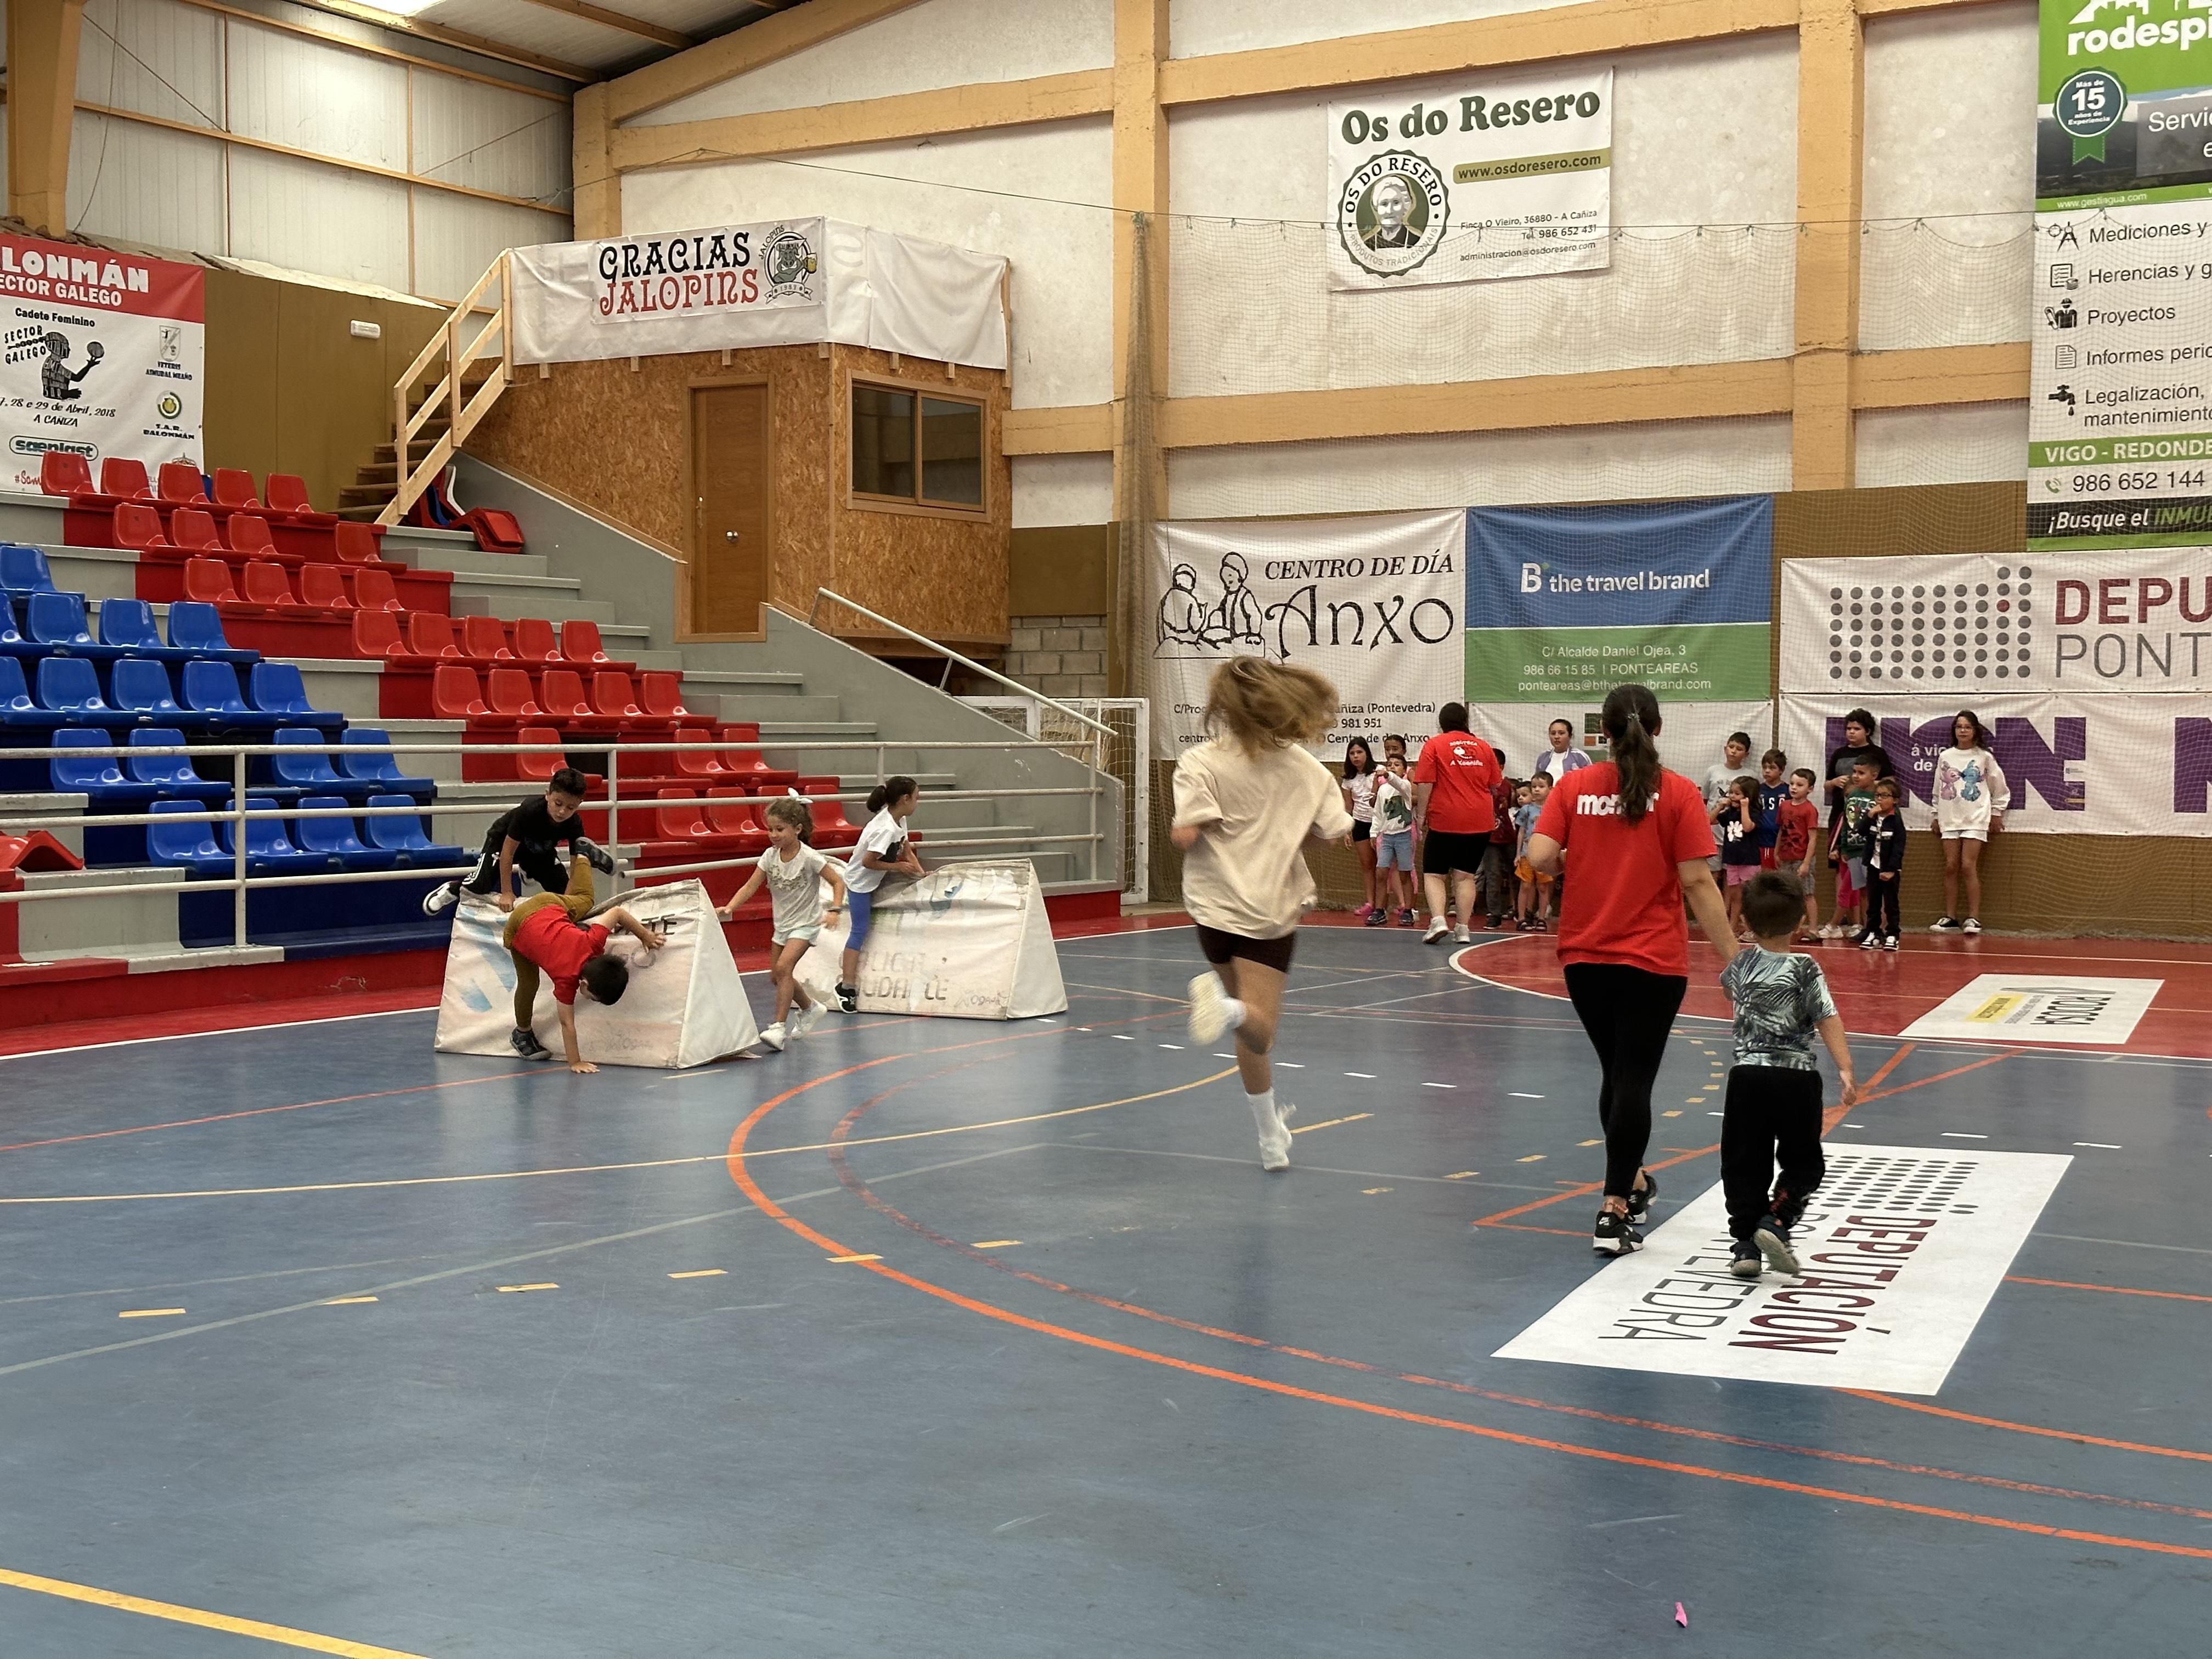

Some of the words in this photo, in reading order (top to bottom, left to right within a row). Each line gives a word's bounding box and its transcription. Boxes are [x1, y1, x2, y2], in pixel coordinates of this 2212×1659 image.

[2072, 87, 2106, 111] 15
[1342, 110, 1388, 144] Os
[1400, 103, 1448, 138] do
[1459, 92, 1600, 132] Resero
[2068, 116, 2110, 126] Experiencia
[1458, 154, 1601, 179] www.osdoresero.com
[1346, 188, 1359, 213] OS
[1357, 163, 1382, 186] DO
[1388, 157, 1442, 206] RESERO
[1524, 214, 1552, 223] 36880
[1571, 210, 1598, 219] Cañiza
[1538, 229, 1558, 239] 986
[1561, 227, 1579, 236] 652
[2090, 222, 2191, 243] Mediciones
[2197, 221, 2208, 238] y
[599, 232, 750, 283] GRACIAS
[2089, 264, 2179, 284] Herencias
[2185, 264, 2195, 280] y
[55, 283, 122, 306] GALEGO
[600, 269, 758, 315] JALOPINS
[15, 308, 49, 320] Cadete
[52, 313, 95, 327] Feminino
[2087, 307, 2175, 326] Proyectos
[4, 325, 43, 343] SECTOR
[5, 346, 47, 364] GALEGO
[2086, 349, 2164, 365] Informes
[2085, 383, 2204, 407] Legalización,
[10, 398, 24, 407] 28
[35, 401, 49, 409] 29
[51, 403, 63, 411] de
[93, 408, 116, 417] 2018
[33, 414, 40, 424] A
[44, 415, 77, 427] CAÑIZA
[2045, 445, 2096, 462] VIGO
[2073, 473, 2111, 493] 986
[2118, 472, 2158, 490] 652
[2167, 470, 2205, 488] 144
[2048, 511, 2126, 534] ¡Busque
[2131, 508, 2149, 526] el
[1265, 558, 1364, 580] CENTRO
[1370, 556, 1405, 577] DE
[1409, 549, 1454, 574] DÍA
[1521, 562, 1542, 593] B
[1549, 574, 1582, 592] the
[1585, 571, 1644, 591] travel
[1649, 568, 1709, 590] brand
[2055, 576, 2212, 625] DEPU
[1265, 584, 1454, 658] Anxo
[1558, 646, 1599, 657] Alcalde
[1602, 645, 1639, 657] Daniel
[1643, 645, 1674, 658] Ojea,
[1678, 645, 1686, 656] 3
[2056, 632, 2212, 678] PONT
[1523, 665, 1544, 675] 986
[1547, 665, 1561, 675] 66
[1565, 664, 1578, 675] 15
[1581, 664, 1595, 675] 85
[1610, 662, 1698, 675] PONTEAREAS
[1368, 702, 1435, 714] (Pontevedra)
[1341, 718, 1361, 729] 981
[1364, 718, 1381, 728] 951
[1914, 758, 1933, 771] de
